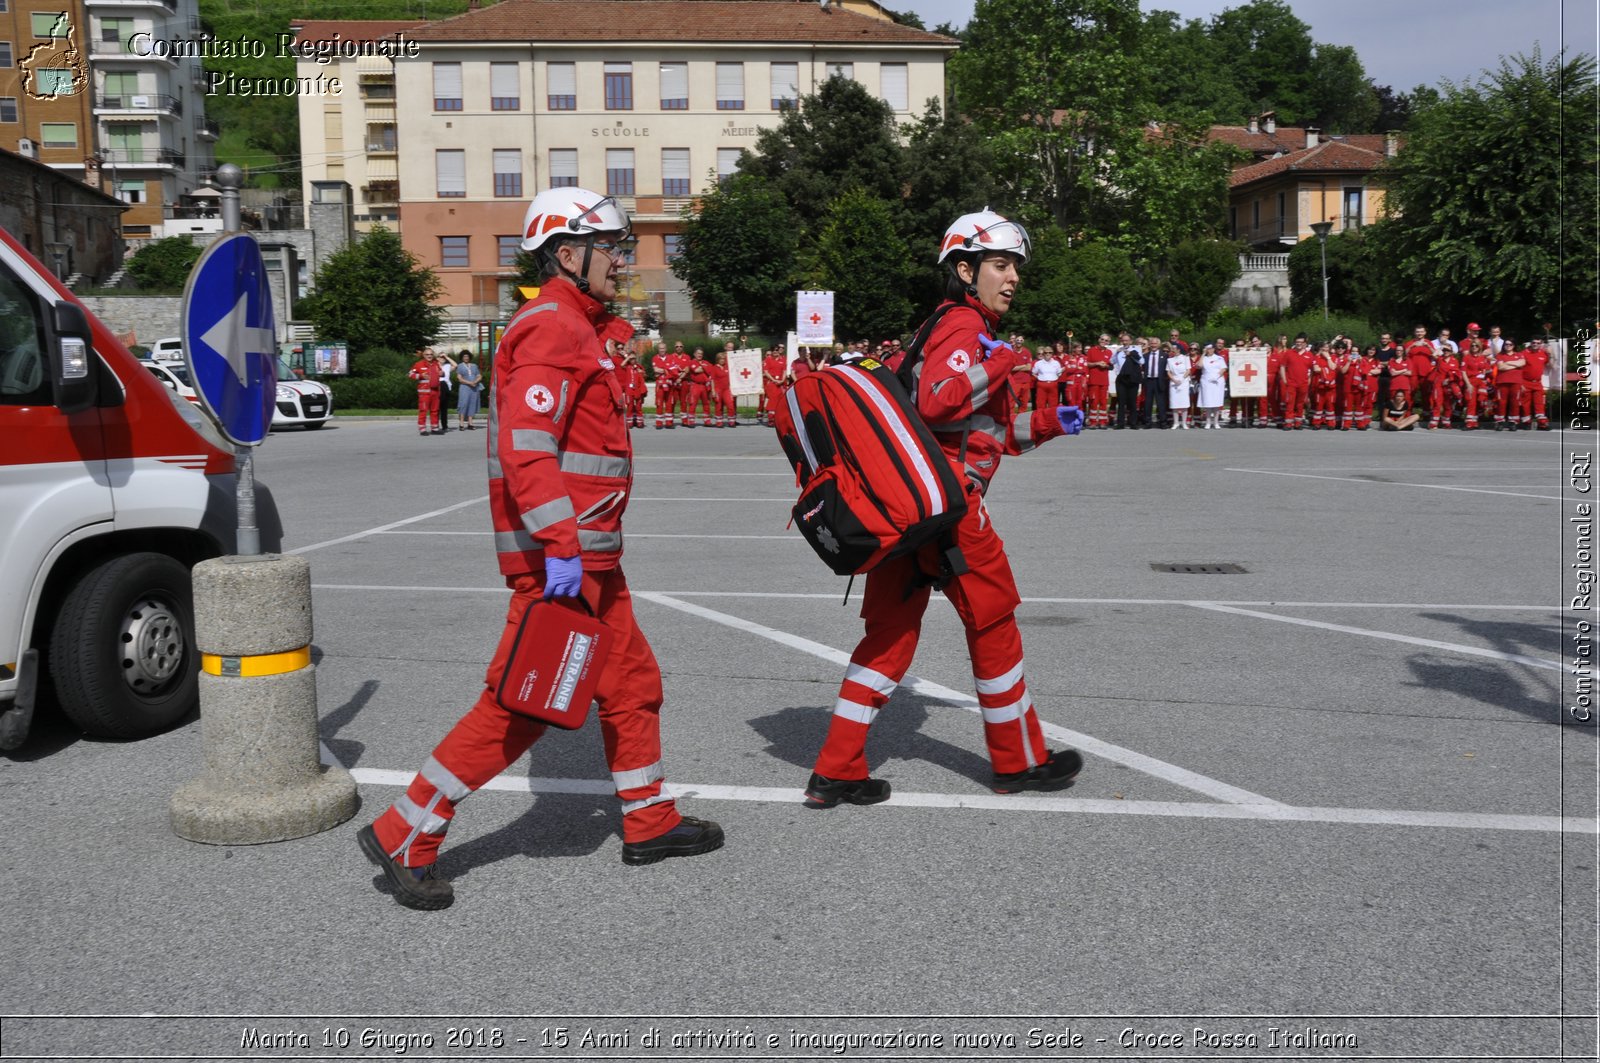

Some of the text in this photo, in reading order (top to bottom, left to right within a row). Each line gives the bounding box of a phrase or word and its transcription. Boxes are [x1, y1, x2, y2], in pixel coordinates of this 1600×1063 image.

[591, 128, 650, 137] SCUOLE
[554, 634, 588, 711] AED TRAINER
